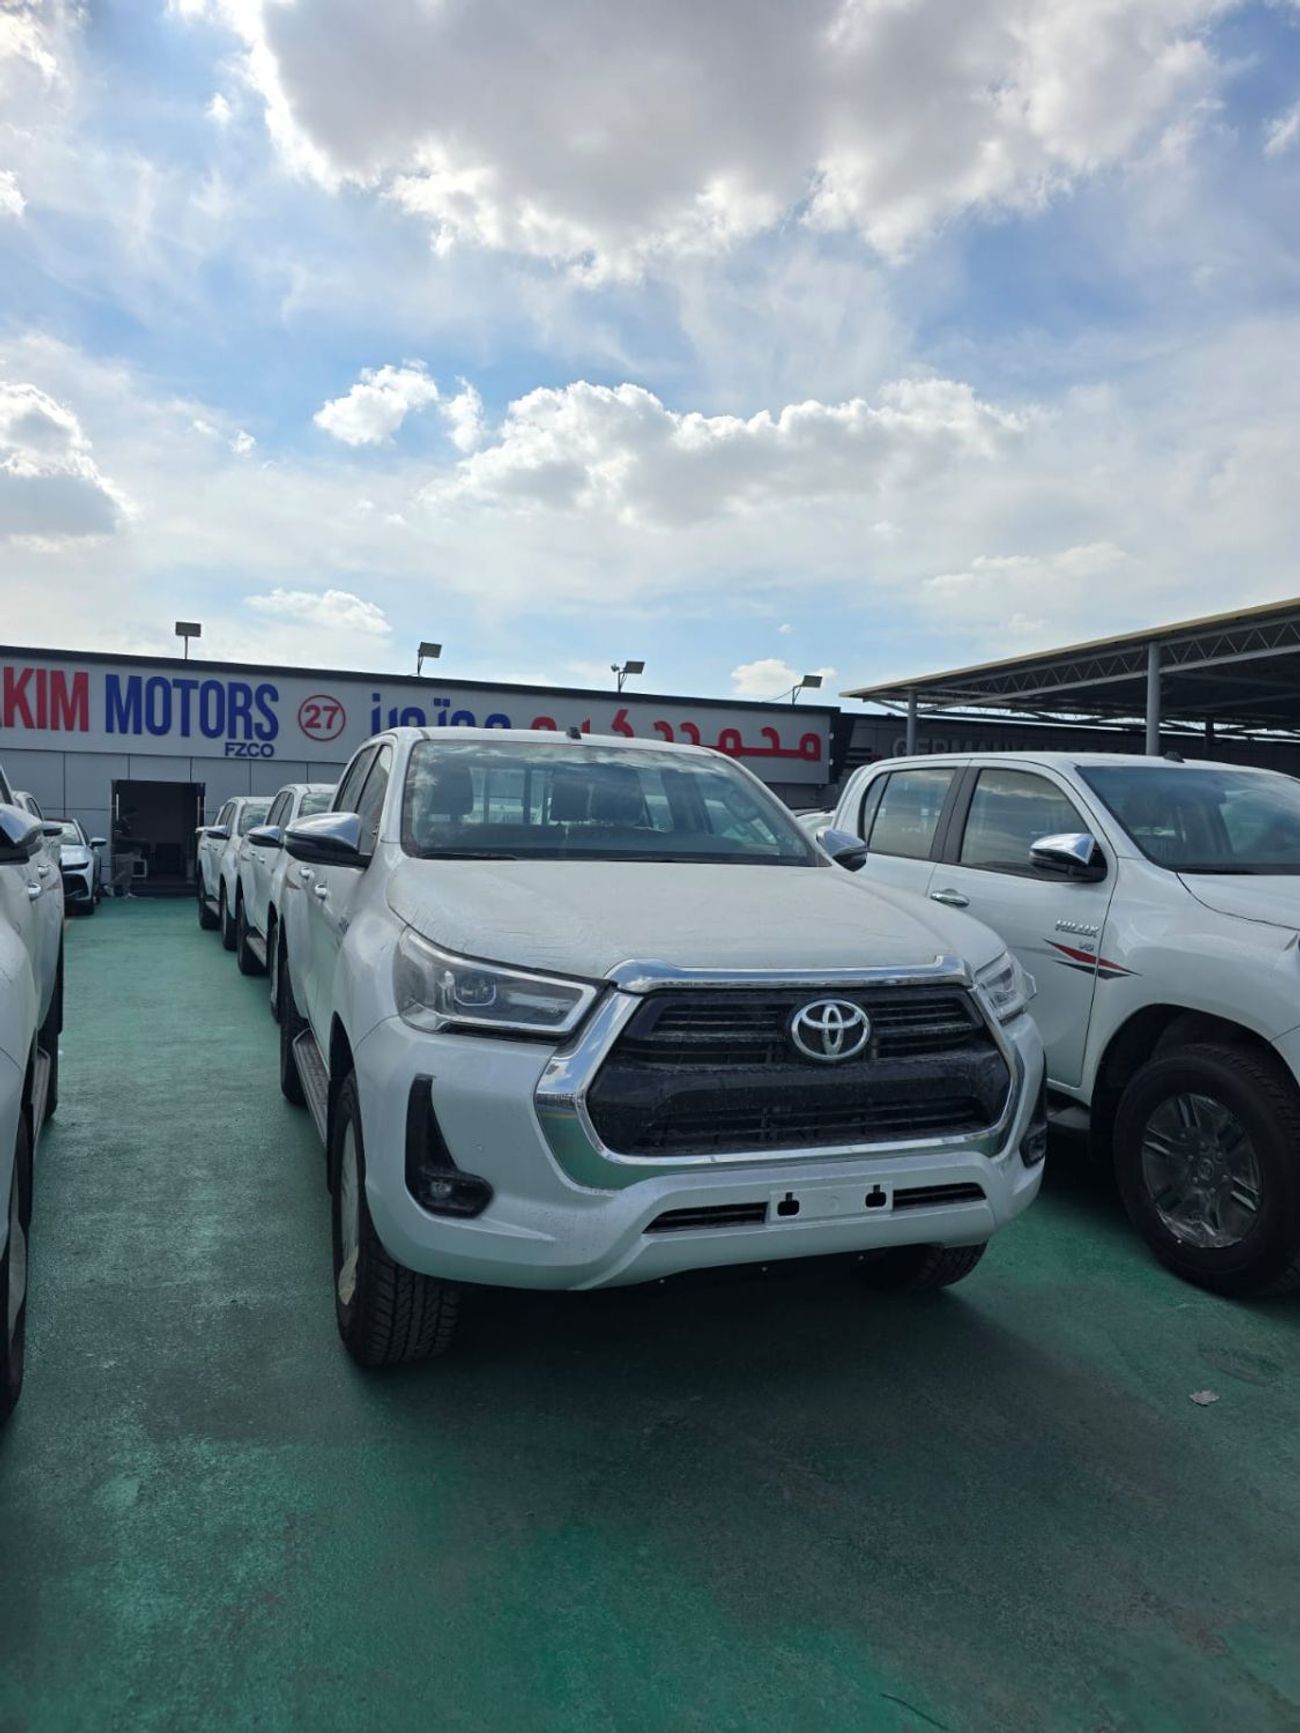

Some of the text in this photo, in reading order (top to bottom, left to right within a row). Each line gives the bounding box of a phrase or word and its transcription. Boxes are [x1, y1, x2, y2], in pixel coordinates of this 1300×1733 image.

[0, 666, 279, 741] KIM MOTORS
[304, 704, 340, 730] 27
[224, 742, 275, 758] FZCO
